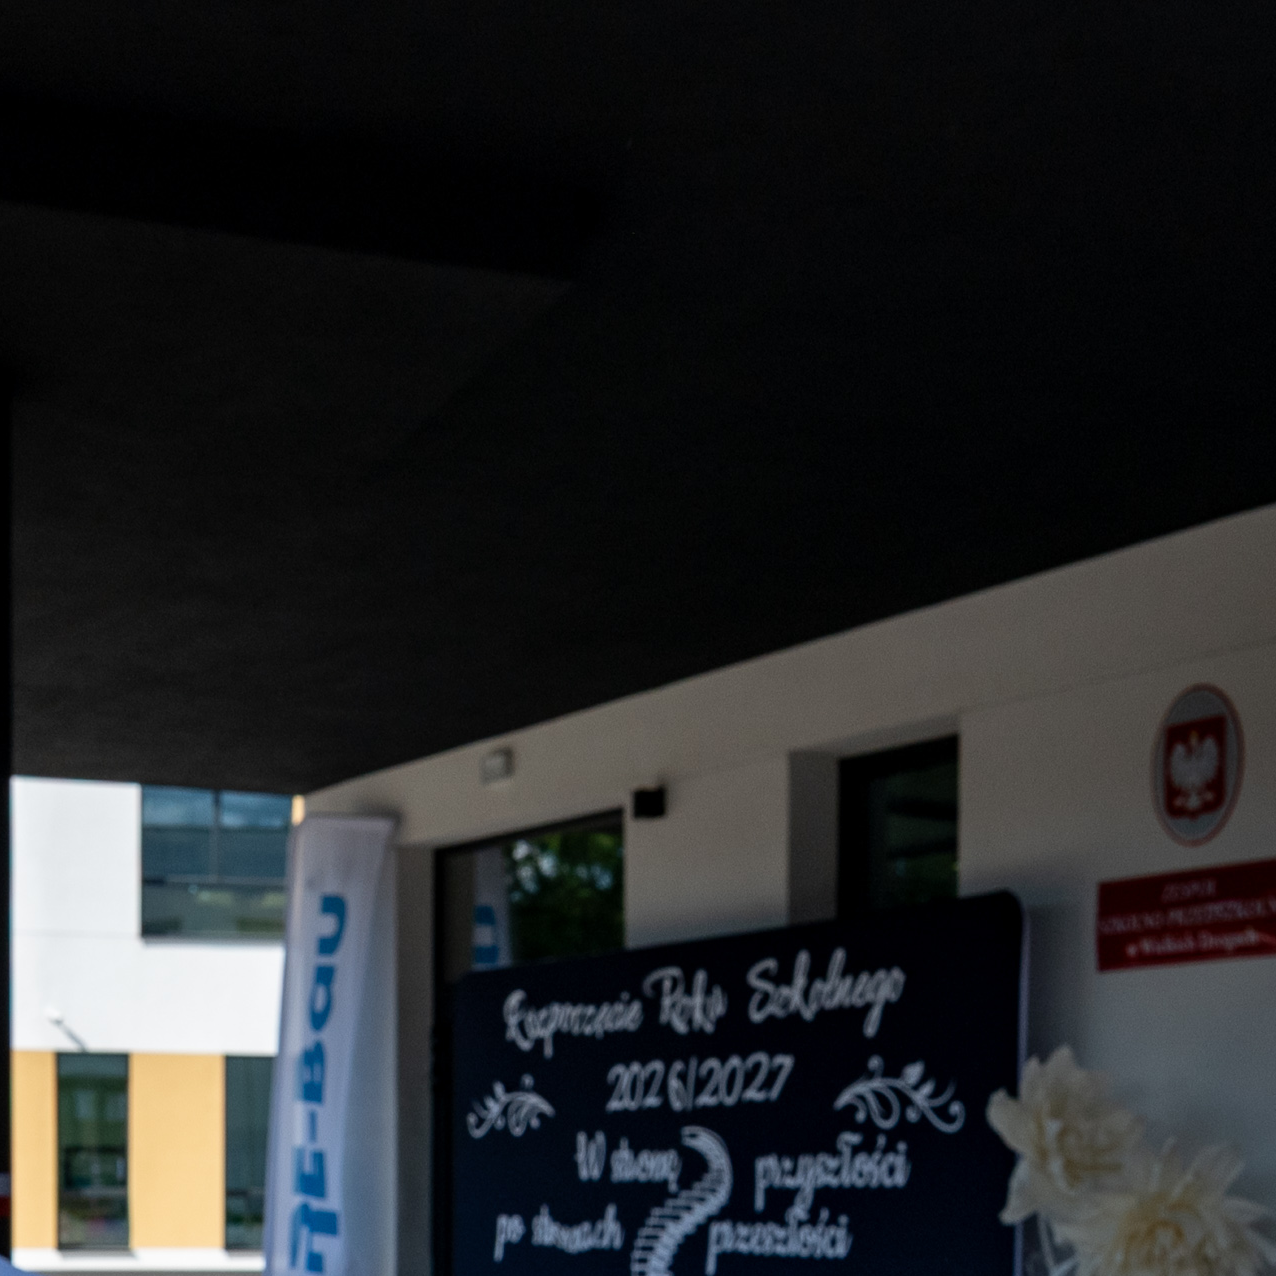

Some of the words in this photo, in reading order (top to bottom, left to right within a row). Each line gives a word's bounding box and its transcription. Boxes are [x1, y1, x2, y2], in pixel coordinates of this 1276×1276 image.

[642, 965, 726, 1034] Roku
[747, 947, 906, 1037] Szkolnego
[606, 1051, 795, 1112] 2026/2027
[754, 1131, 911, 1212] przyszłości
[493, 1212, 526, 1263] po
